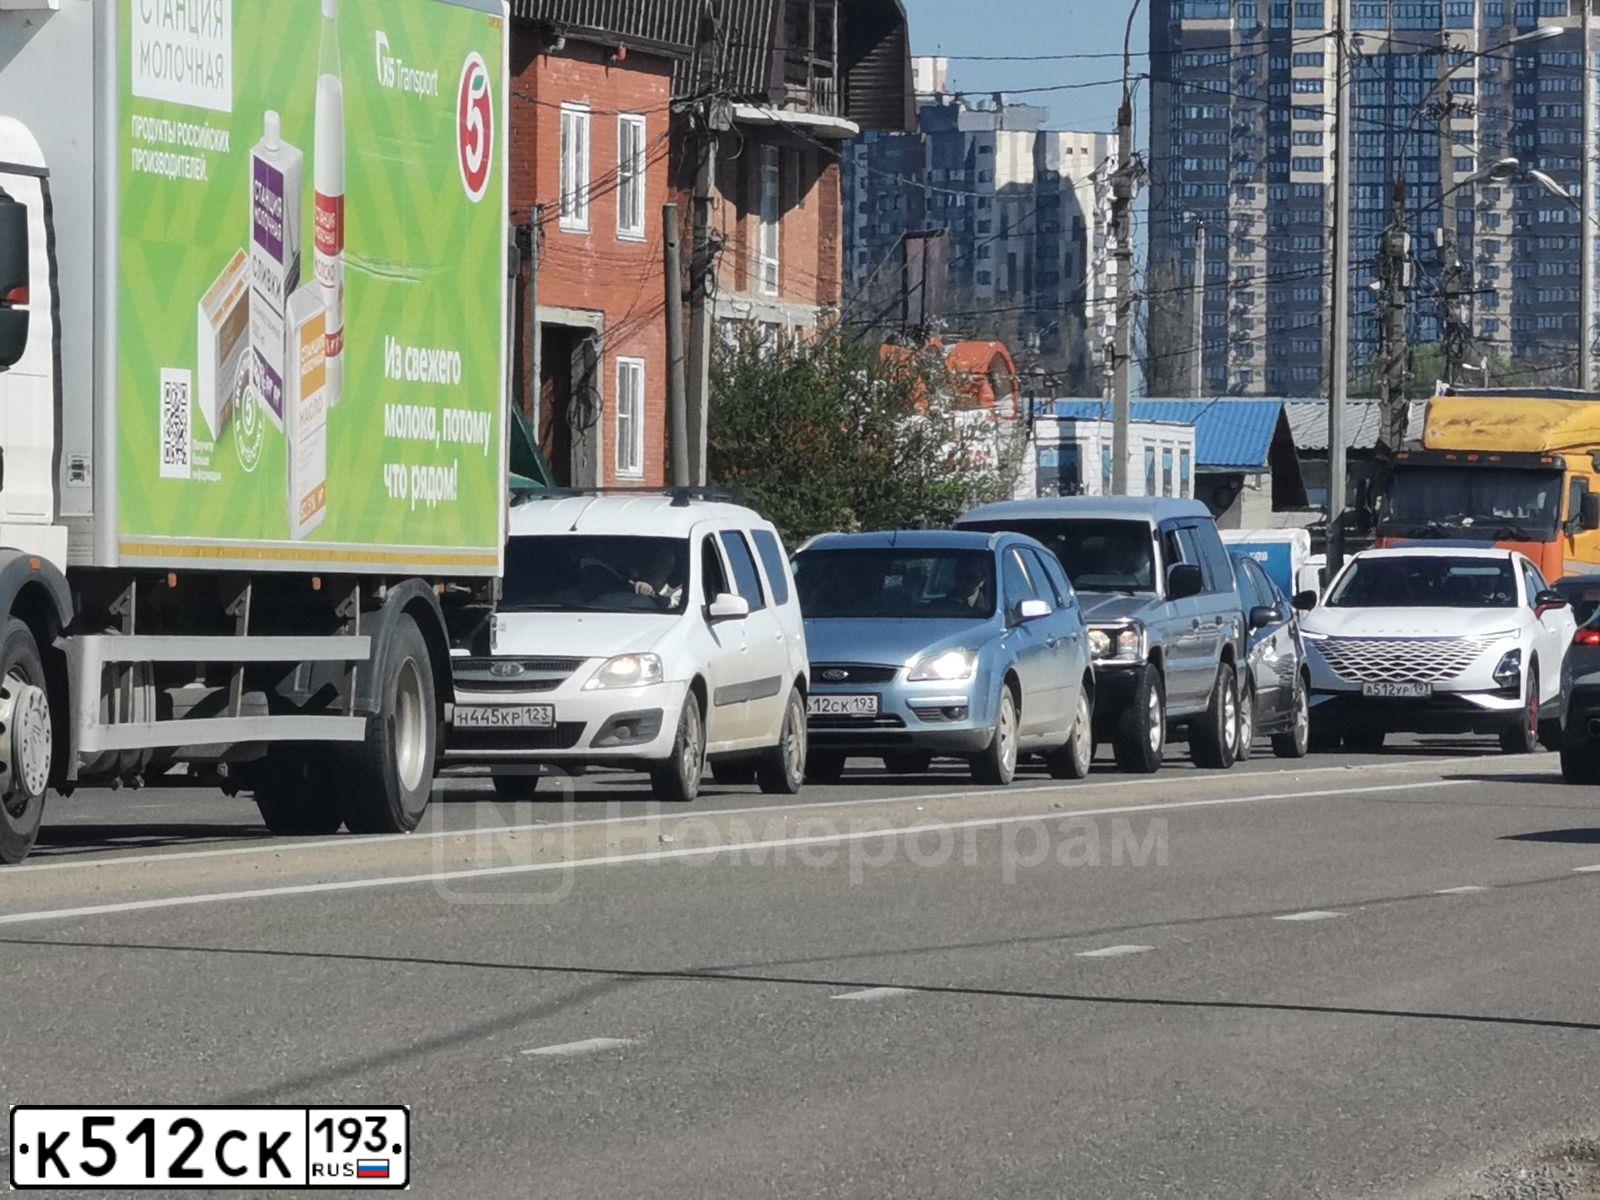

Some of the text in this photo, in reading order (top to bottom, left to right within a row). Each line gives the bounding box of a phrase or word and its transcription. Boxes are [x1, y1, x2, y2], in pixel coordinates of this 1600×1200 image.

[140, 0, 223, 41] СТАНЦИЯ
[140, 38, 223, 90] МОЛОЧНАЯ
[396, 59, 439, 101] Transport
[132, 115, 230, 153] ПРОДУКТЫ РОССИЙСКИХ
[384, 335, 402, 380] Из
[405, 346, 461, 385] свежего
[384, 403, 492, 457] молока, потому
[384, 458, 458, 511] что рядом!
[525, 707, 549, 720] 123
